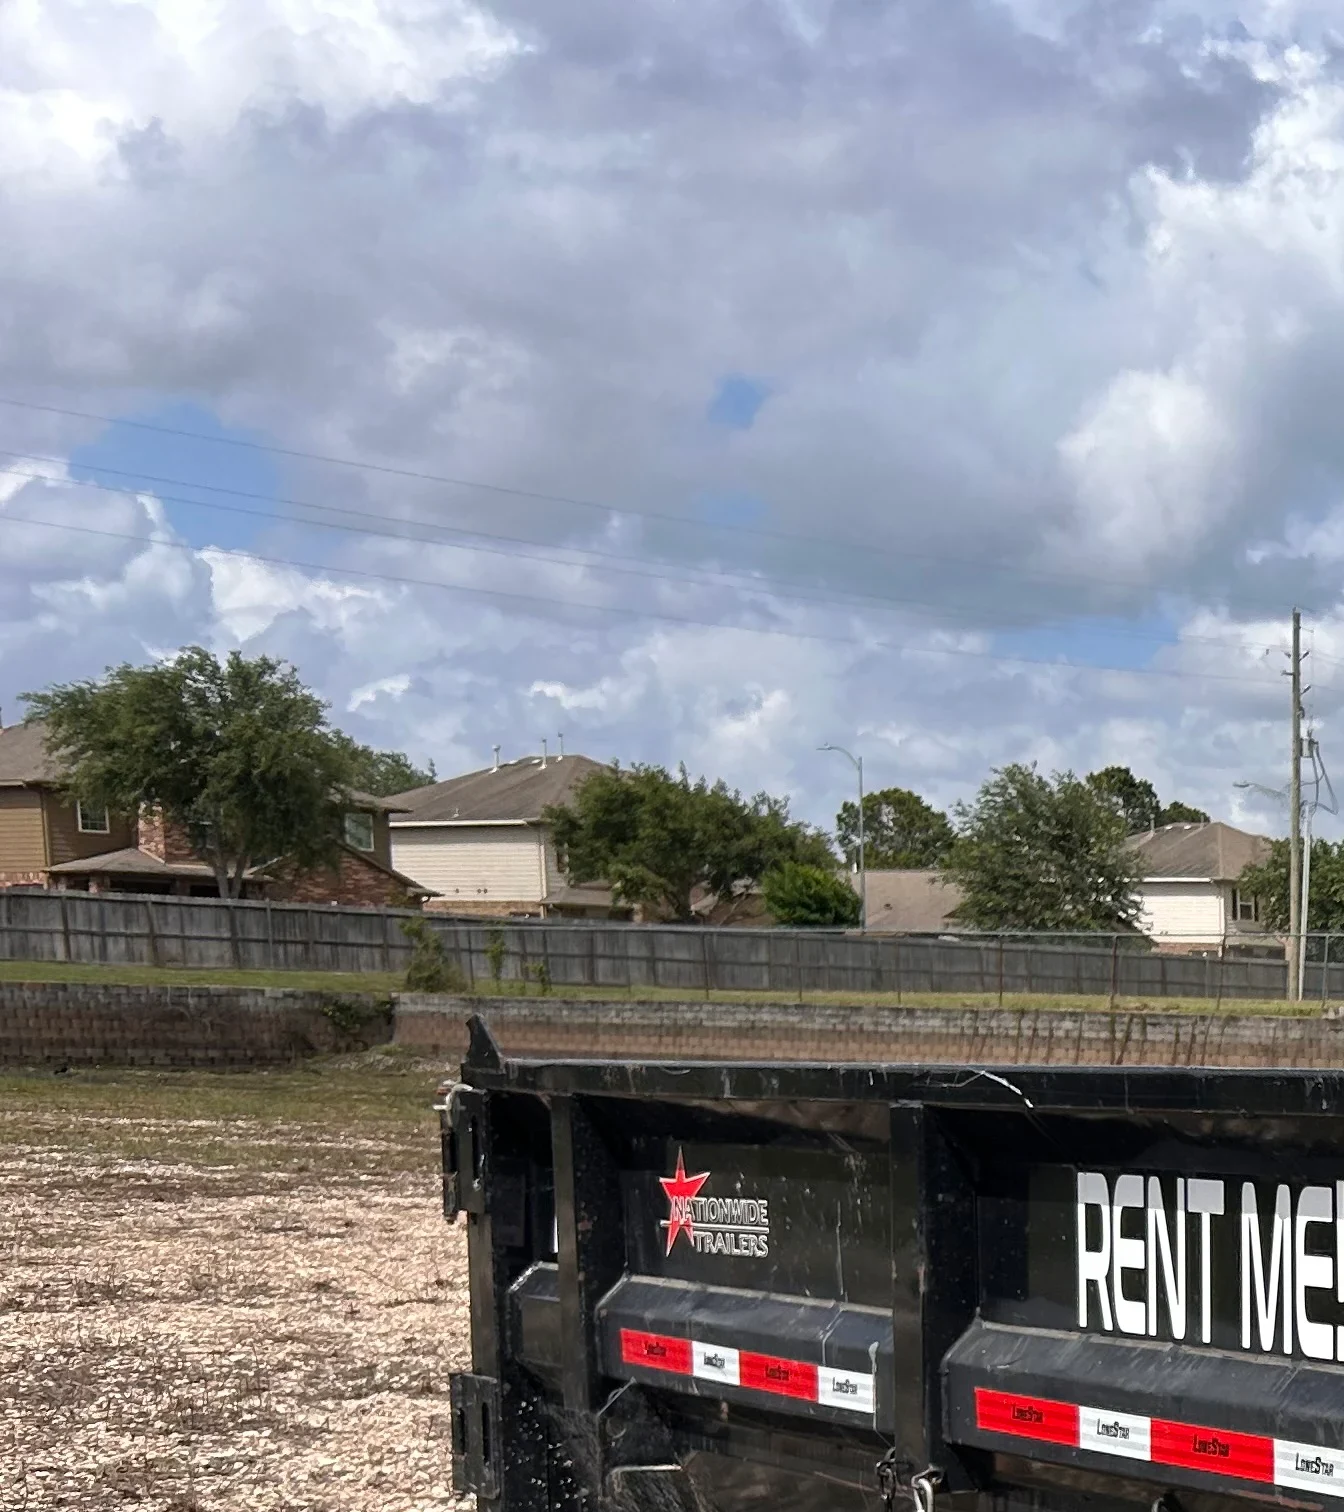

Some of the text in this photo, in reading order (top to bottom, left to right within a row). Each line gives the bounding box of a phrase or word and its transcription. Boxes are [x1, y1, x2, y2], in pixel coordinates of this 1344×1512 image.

[671, 1195, 769, 1226] NATIONWIDE
[693, 1230, 769, 1258] TRAILERS
[1077, 1172, 1225, 1344] RENT
